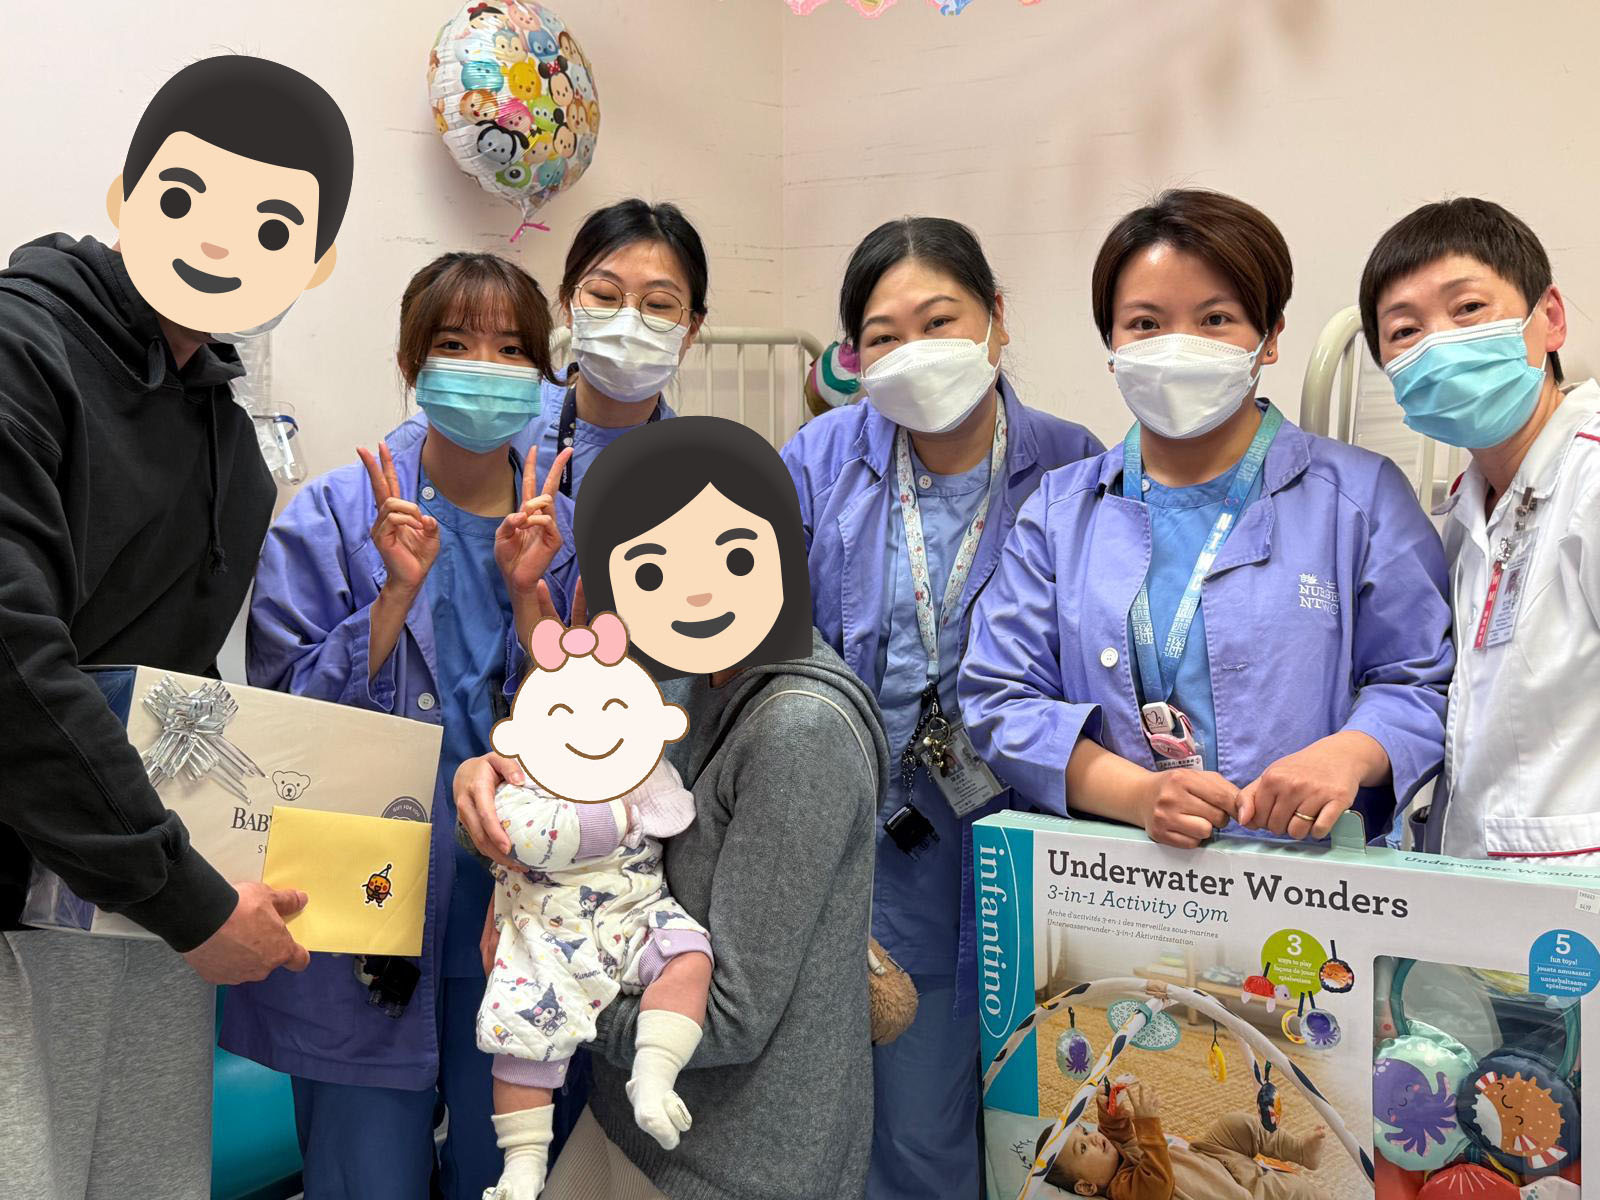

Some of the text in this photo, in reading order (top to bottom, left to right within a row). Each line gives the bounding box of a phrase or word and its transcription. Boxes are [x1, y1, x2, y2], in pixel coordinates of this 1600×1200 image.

[1404, 856, 1600, 879] Underwater Wonders
[1047, 849, 1408, 918] Underwater Wonders
[1047, 884, 1229, 924] 3-in-1 Activity Gym
[980, 844, 1007, 1016] infantino
[1047, 908, 1067, 918] Arche
[1122, 918, 1134, 927] des
[1135, 921, 1171, 932] merveilles
[1171, 927, 1219, 939] sous-marines
[1047, 918, 1111, 934] Unterwasserwunder
[1286, 934, 1302, 956] 3
[1555, 933, 1571, 955] 5
[1550, 955, 1561, 964] fun
